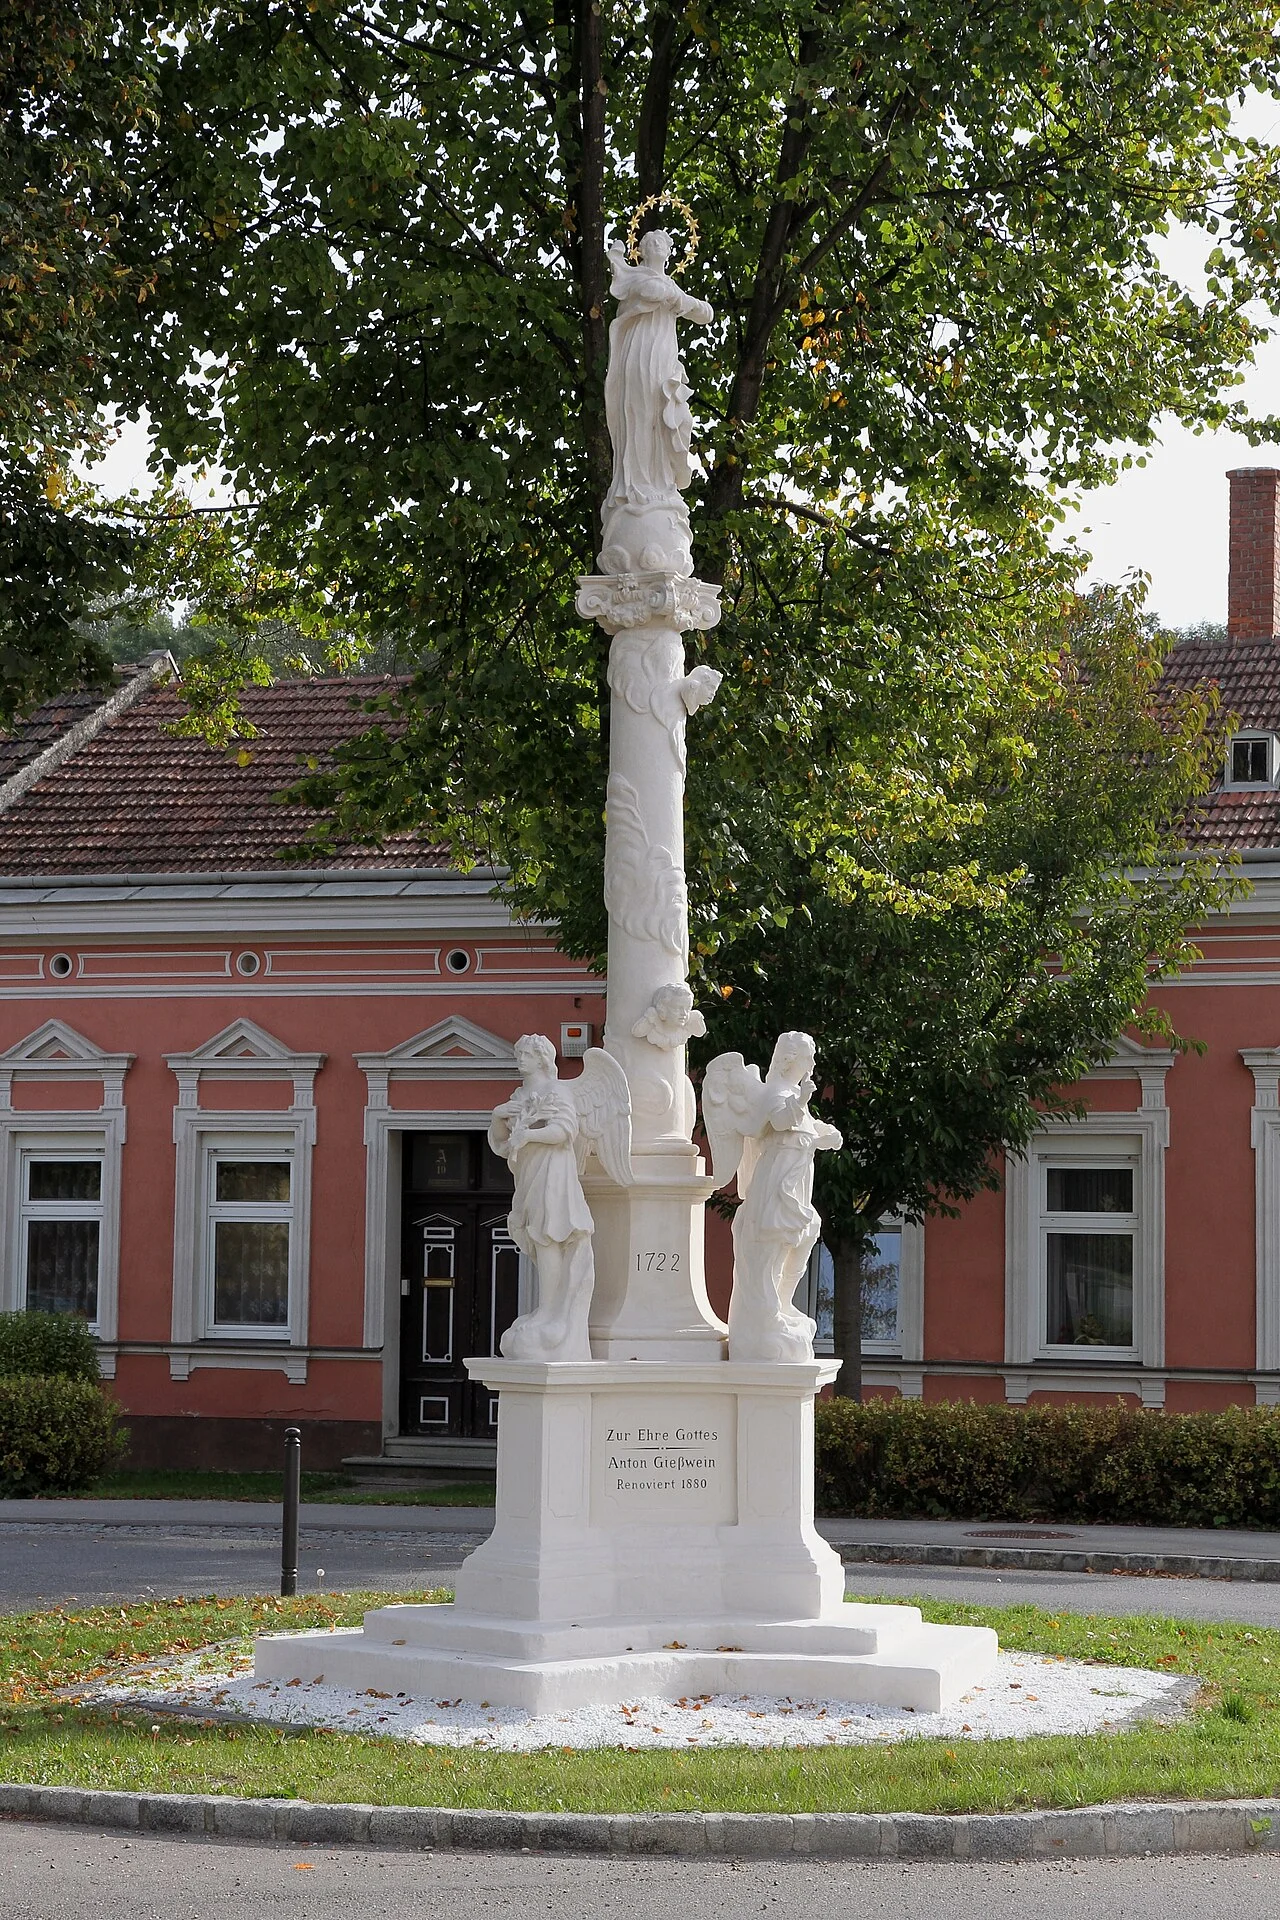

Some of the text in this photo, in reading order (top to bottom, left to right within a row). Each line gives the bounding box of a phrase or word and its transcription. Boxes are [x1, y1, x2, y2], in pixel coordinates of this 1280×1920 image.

[636, 1252, 680, 1272] 1722
[606, 1428, 718, 1441] Zur Ehre Gottes
[608, 1456, 716, 1470] Anton Gießwein
[616, 1478, 707, 1490] Renoviert 1880
